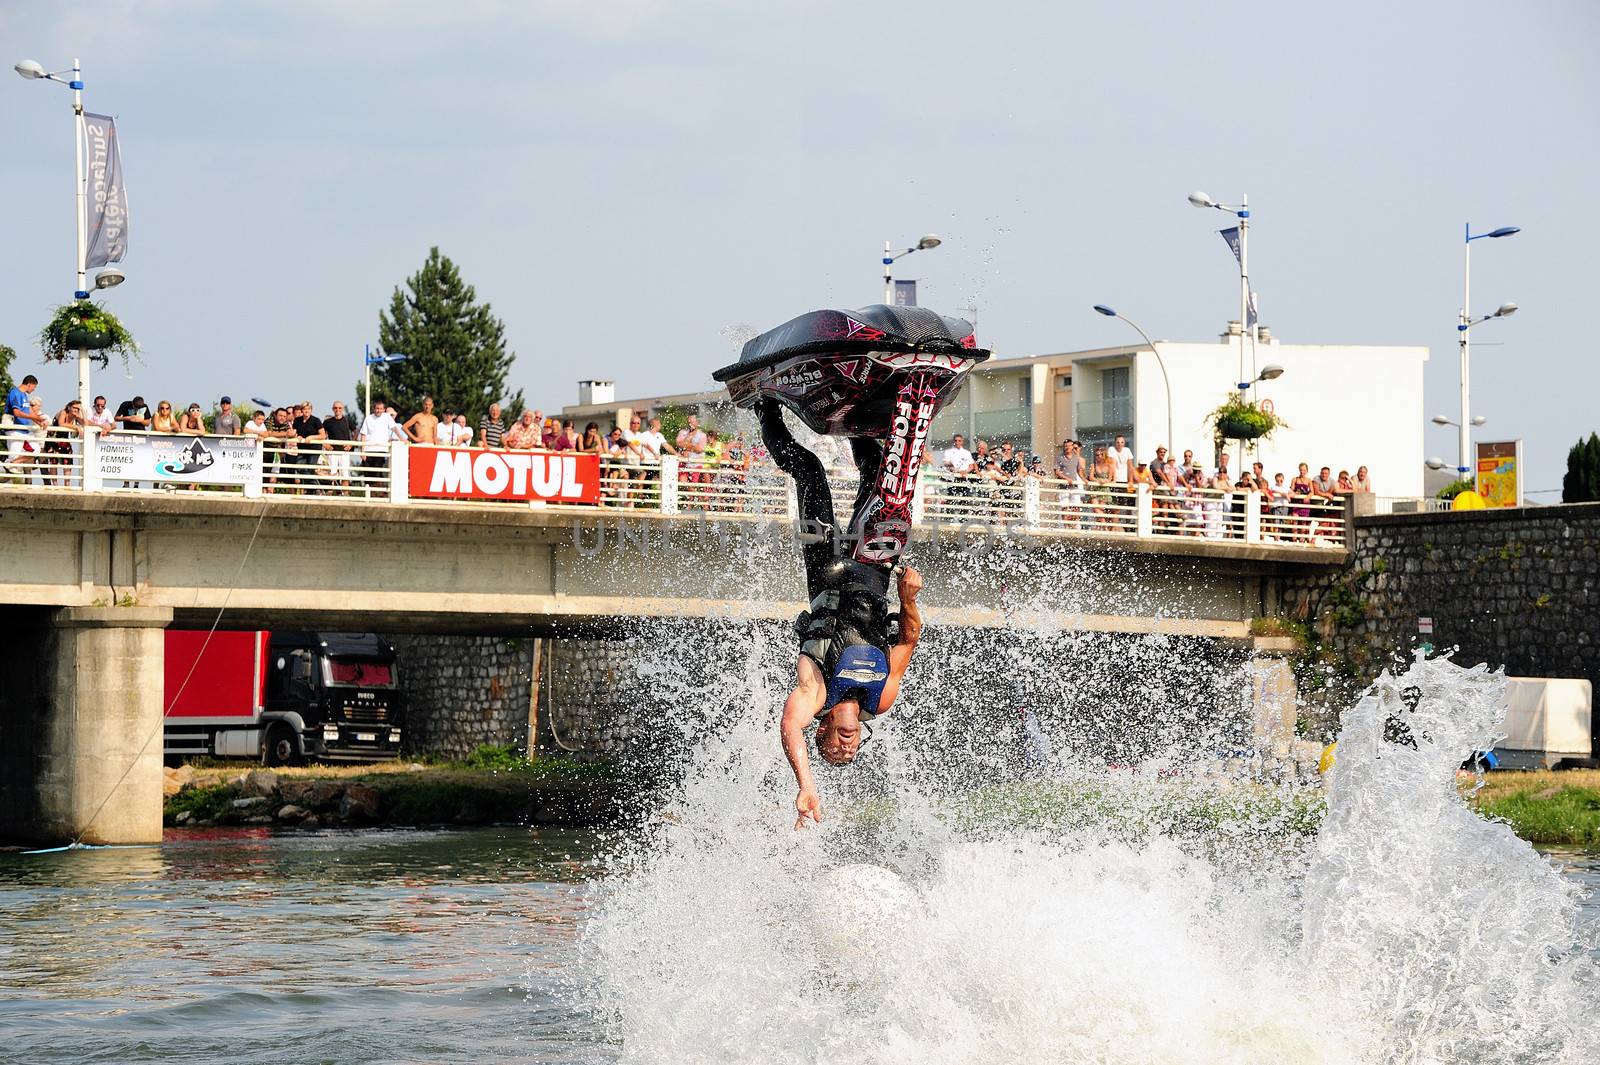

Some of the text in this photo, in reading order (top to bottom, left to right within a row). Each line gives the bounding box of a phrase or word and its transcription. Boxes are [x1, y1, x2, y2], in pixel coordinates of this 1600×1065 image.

[100, 445, 134, 454] HOMMES
[882, 401, 912, 493] FORCE
[100, 455, 134, 464] FEMMES
[196, 451, 212, 465] ME
[100, 465, 121, 474] ADOS
[429, 451, 584, 499] MOTUL
[357, 692, 375, 700] IVECO
